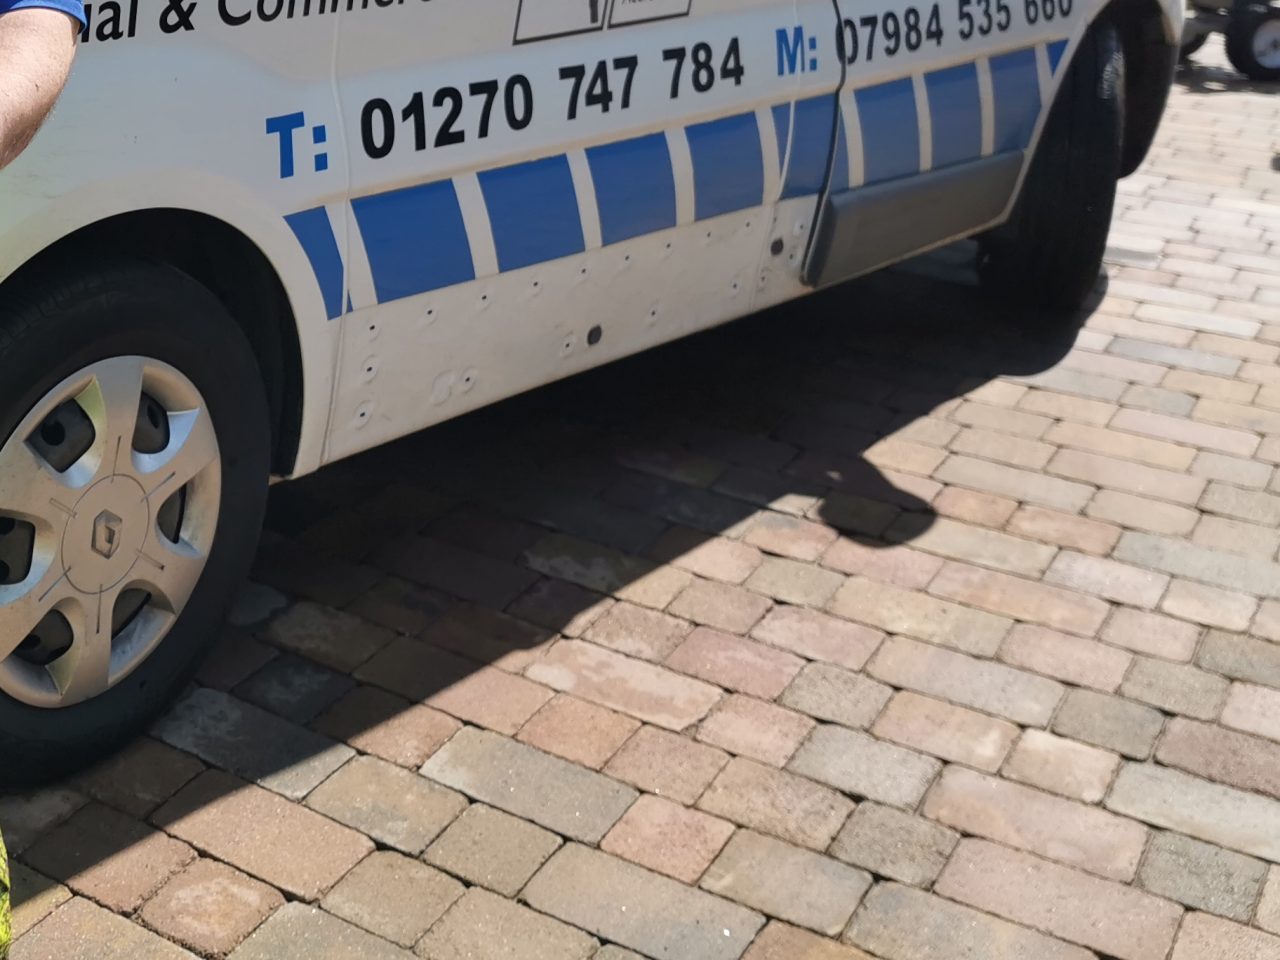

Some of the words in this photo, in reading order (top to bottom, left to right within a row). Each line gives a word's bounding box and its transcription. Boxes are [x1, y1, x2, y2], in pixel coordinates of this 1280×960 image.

[775, 25, 818, 76] M:
[835, 3, 944, 66] 07984
[266, 112, 329, 179] T:
[359, 74, 534, 160] 01270
[558, 55, 639, 120] 747
[662, 37, 744, 100] 784
